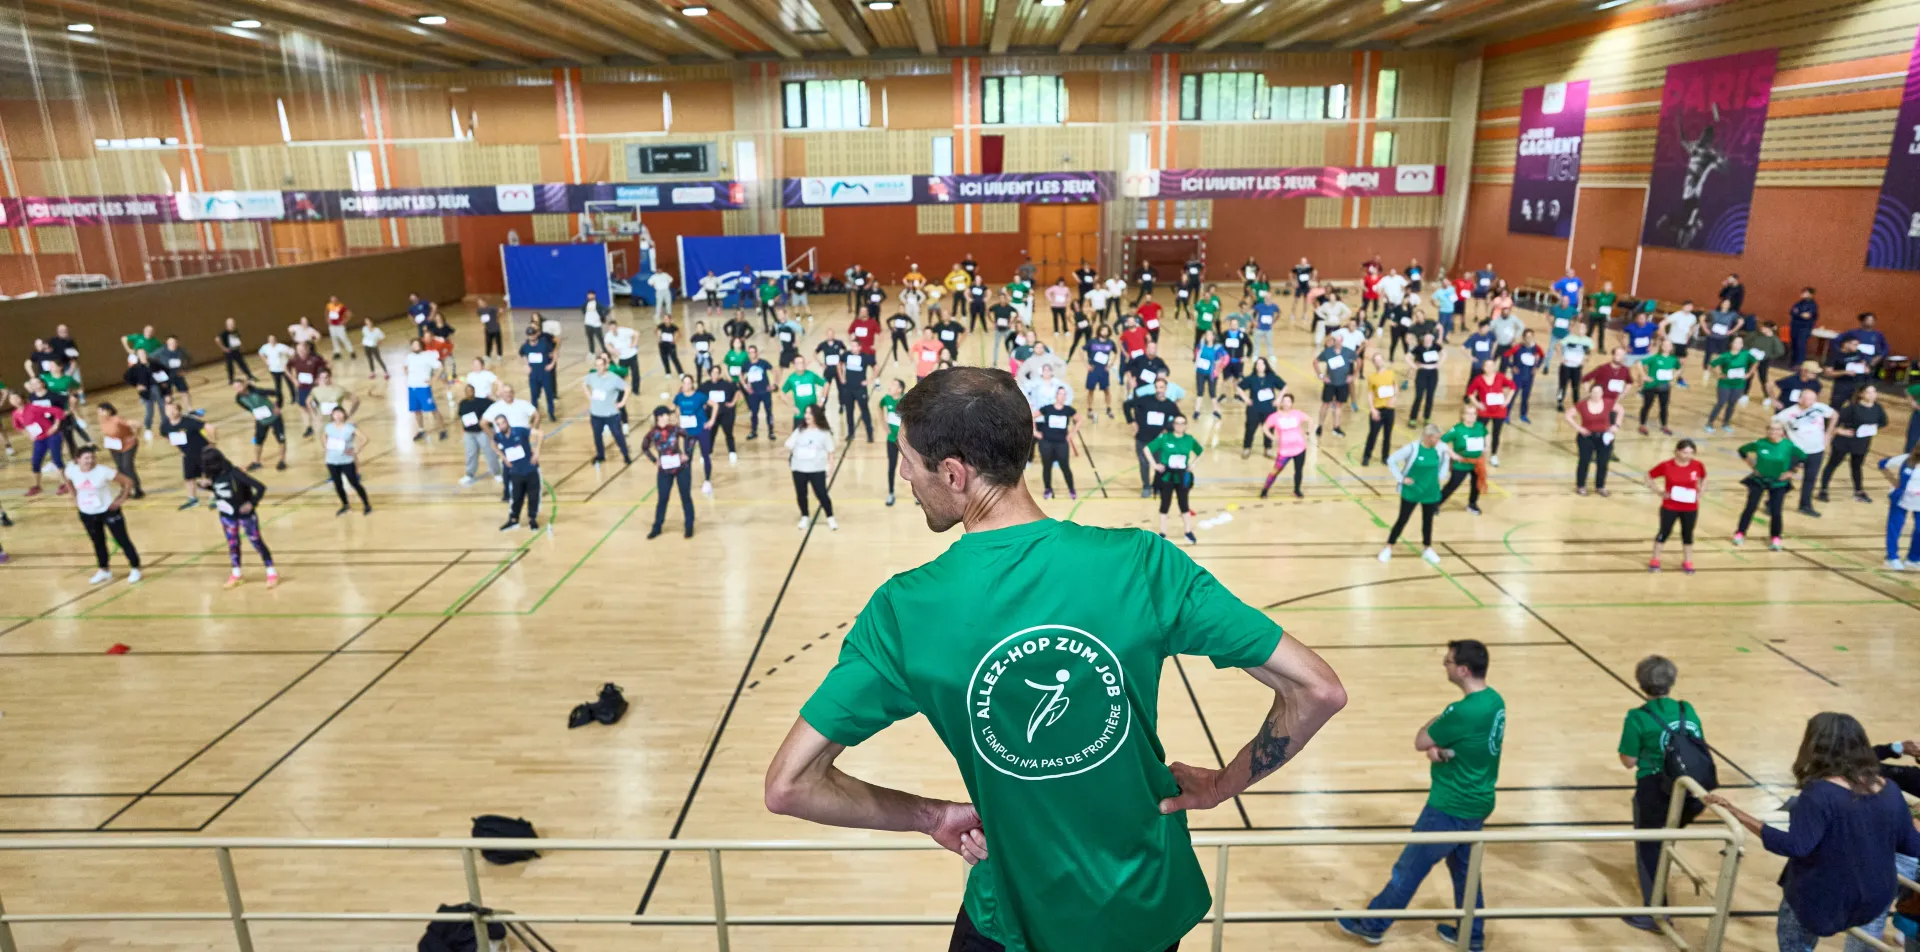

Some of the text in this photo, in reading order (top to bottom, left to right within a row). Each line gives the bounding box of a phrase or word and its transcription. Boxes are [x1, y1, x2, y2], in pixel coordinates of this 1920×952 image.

[1661, 64, 1774, 116] PARIS
[960, 179, 1095, 196] ICI VIVENT LES JEUX
[1181, 175, 1317, 191] ICI VIVENT LES JEUX
[26, 203, 50, 217] ICI
[99, 201, 124, 216] LES
[340, 196, 362, 212] ICI
[411, 195, 437, 210] LES
[437, 194, 470, 209] JEUX
[977, 637, 1121, 719] ALLEZ-HOP ZUM JOB
[982, 704, 1121, 769] L'EMPLOI N'A PAS DE FRONTIÈRE
